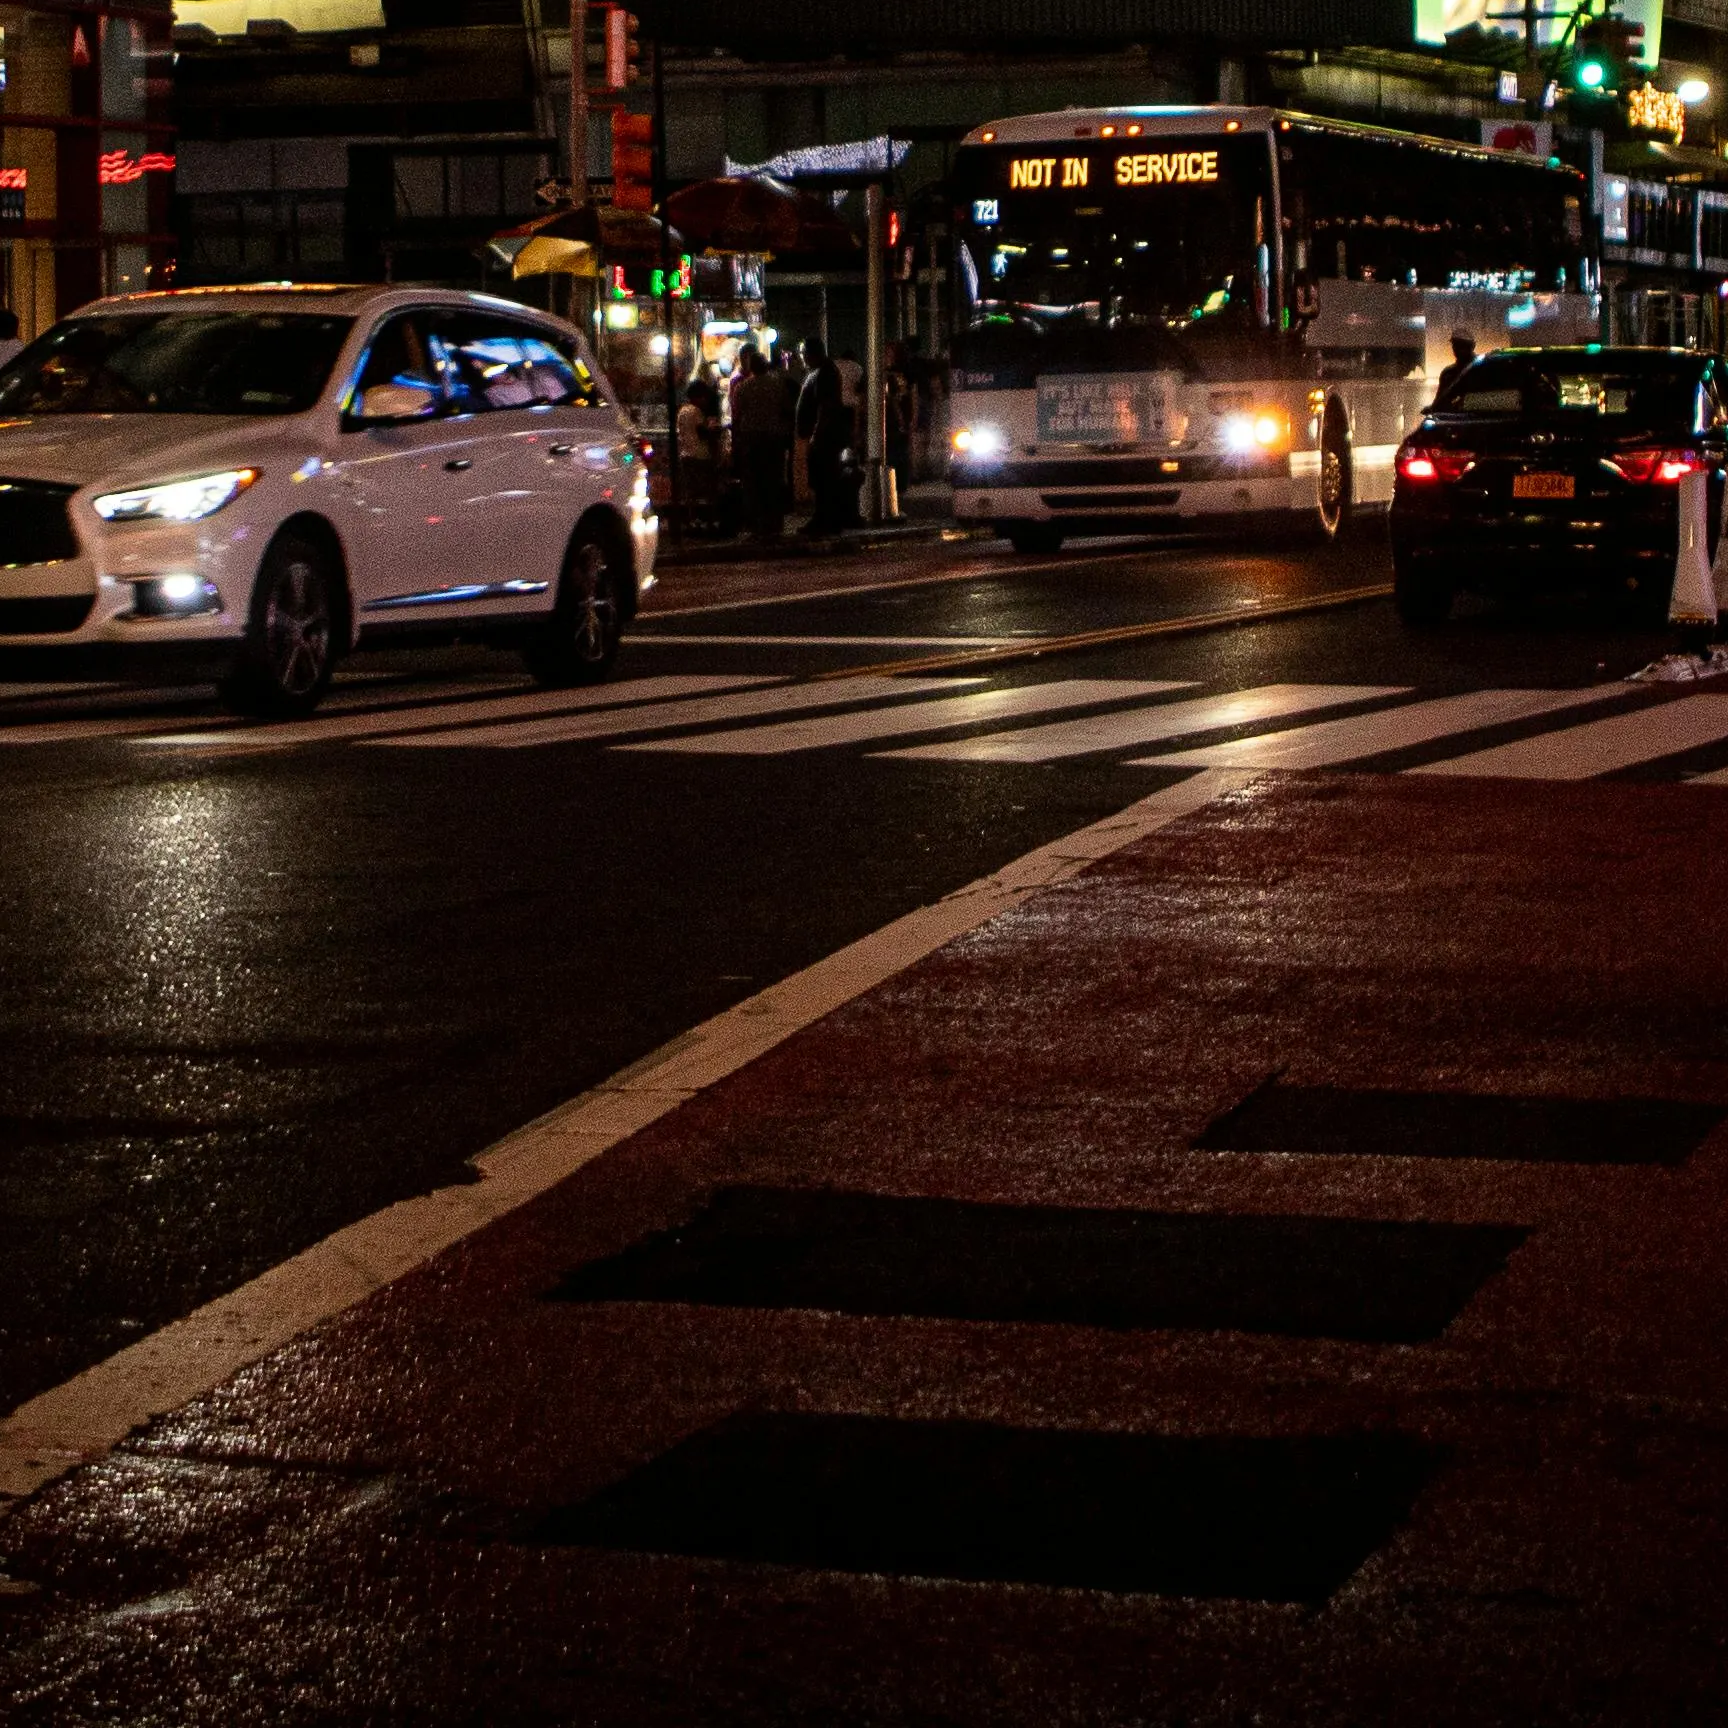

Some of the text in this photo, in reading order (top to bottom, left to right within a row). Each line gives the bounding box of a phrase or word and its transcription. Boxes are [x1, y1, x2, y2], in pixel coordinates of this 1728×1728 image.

[1011, 152, 1218, 188] NOT IN SERVICE
[975, 200, 998, 221] 721
